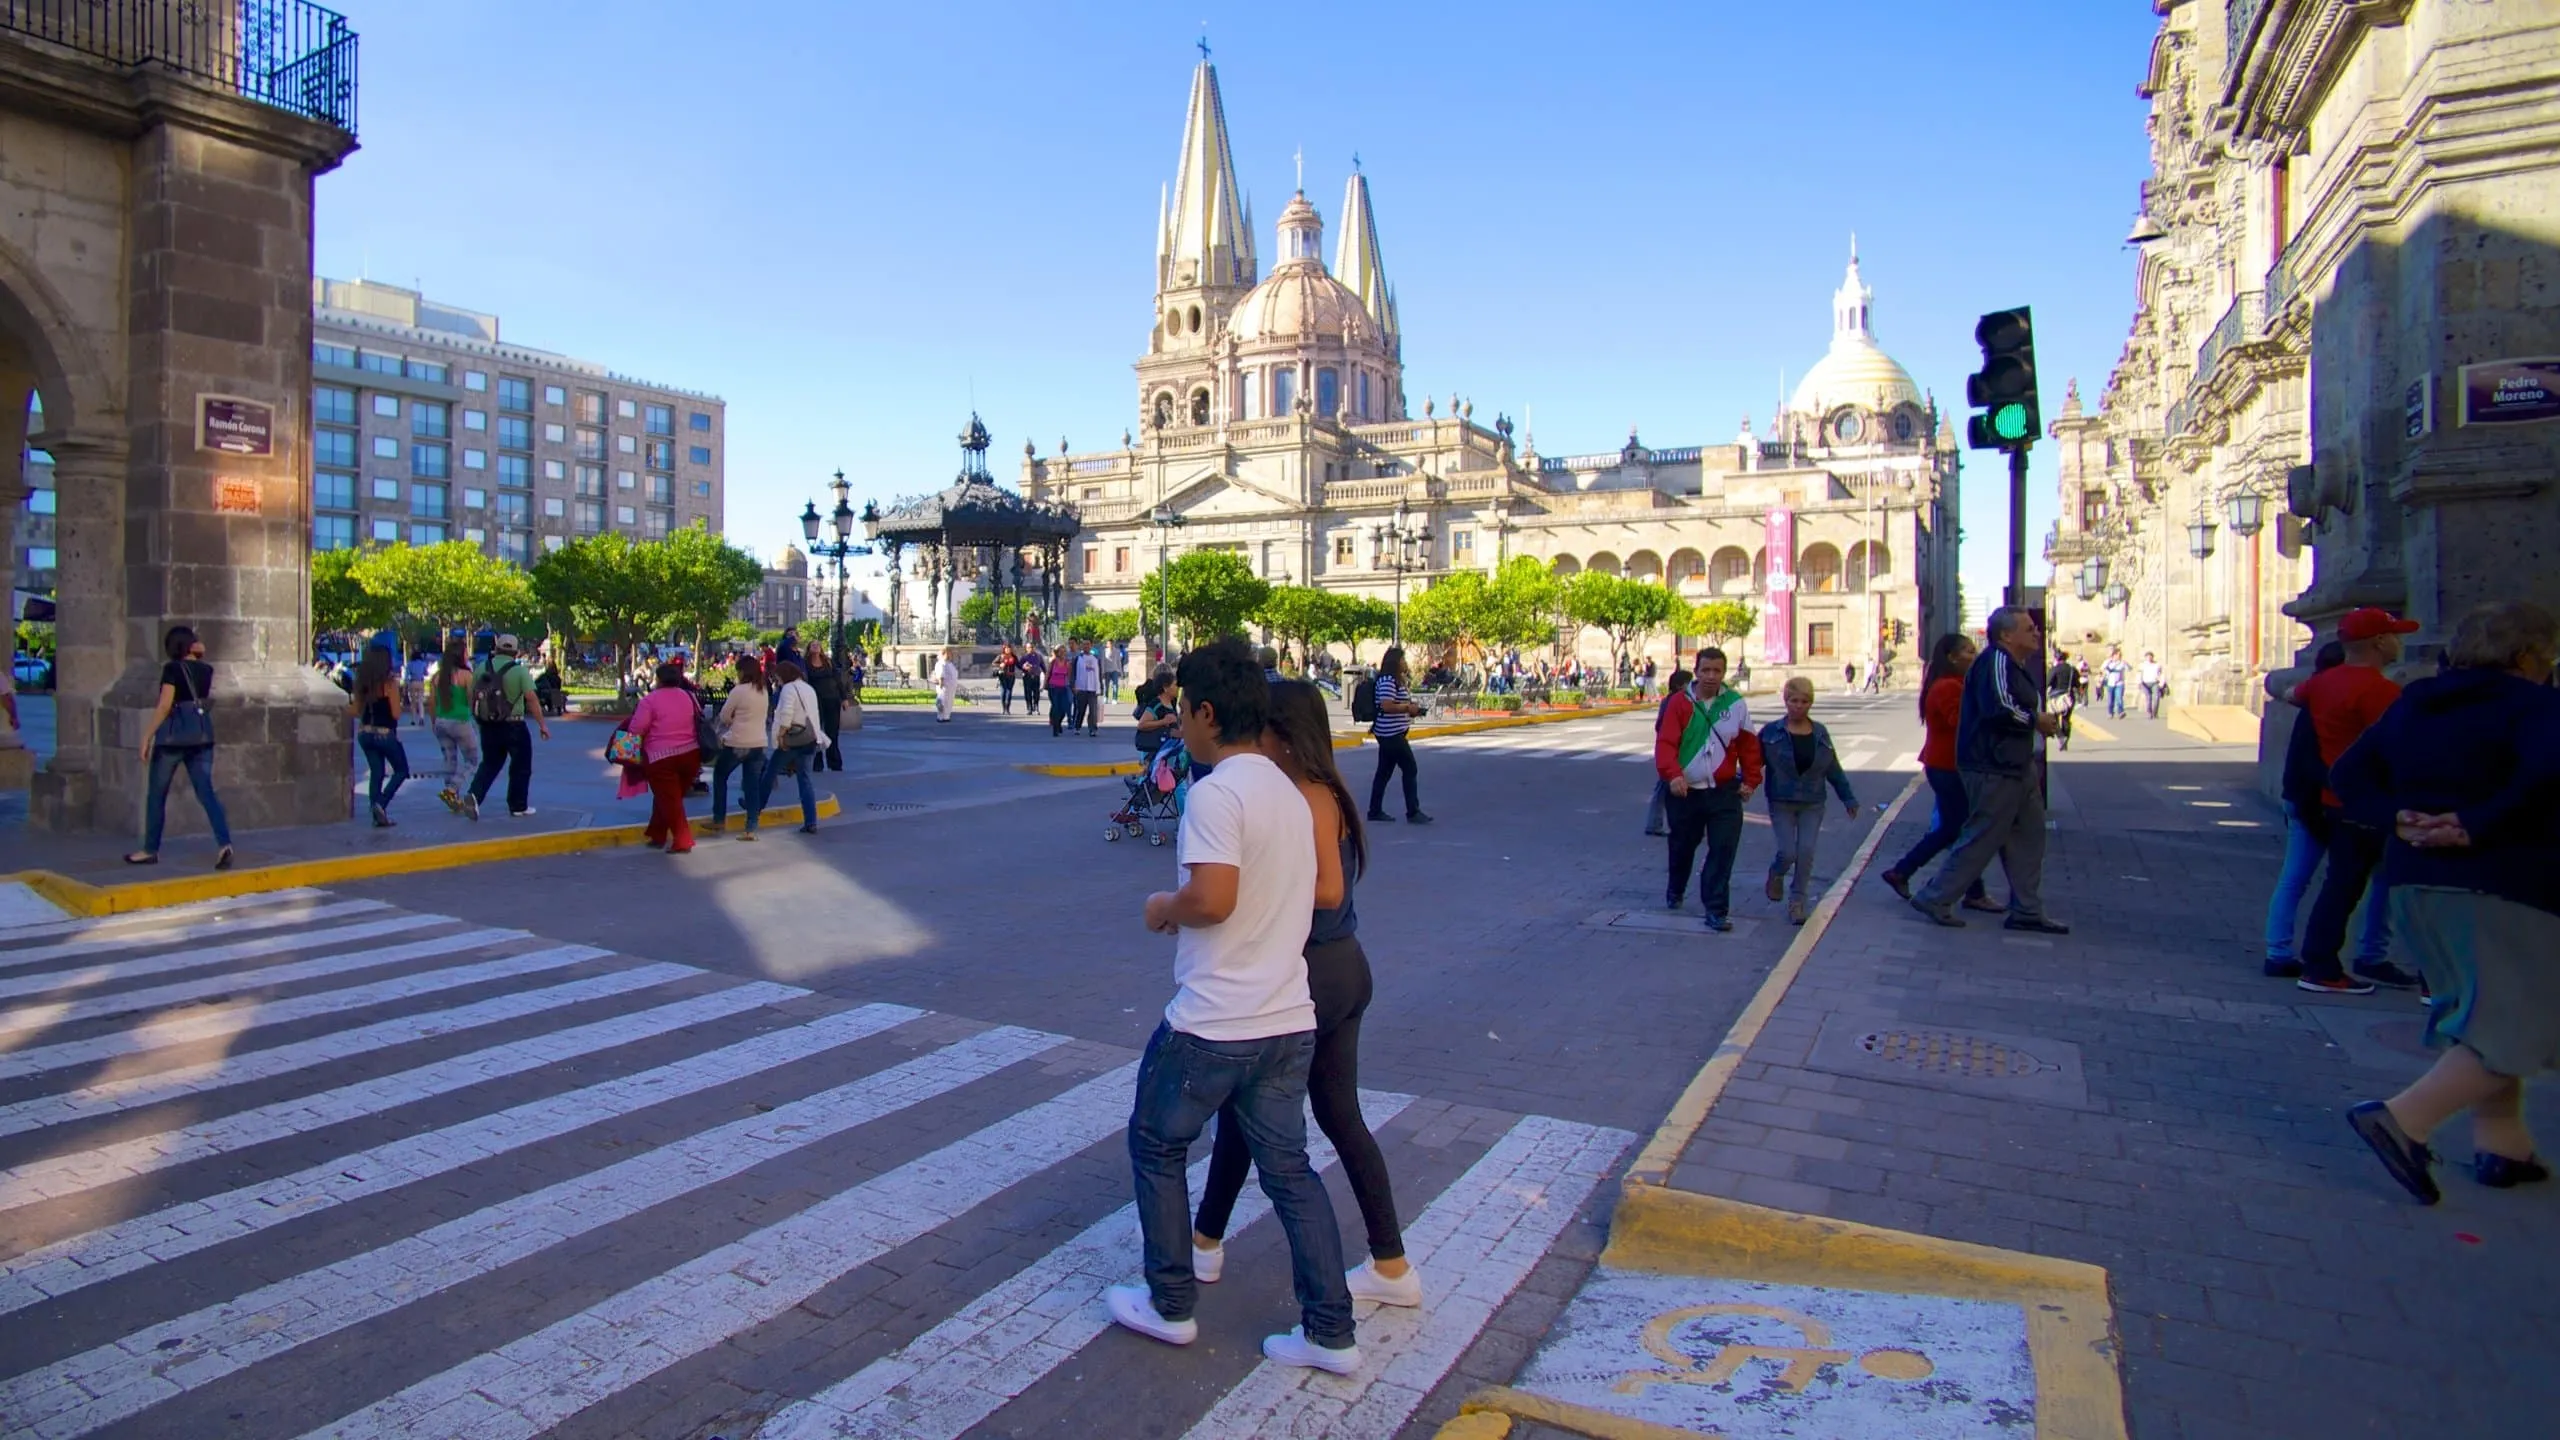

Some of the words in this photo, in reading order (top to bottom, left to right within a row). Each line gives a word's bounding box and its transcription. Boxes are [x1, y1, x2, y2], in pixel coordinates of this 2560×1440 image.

[2499, 377, 2538, 388] Pedro
[2493, 391, 2543, 401] Moreno
[209, 417, 237, 431] Ramón
[239, 422, 266, 435] Corona
